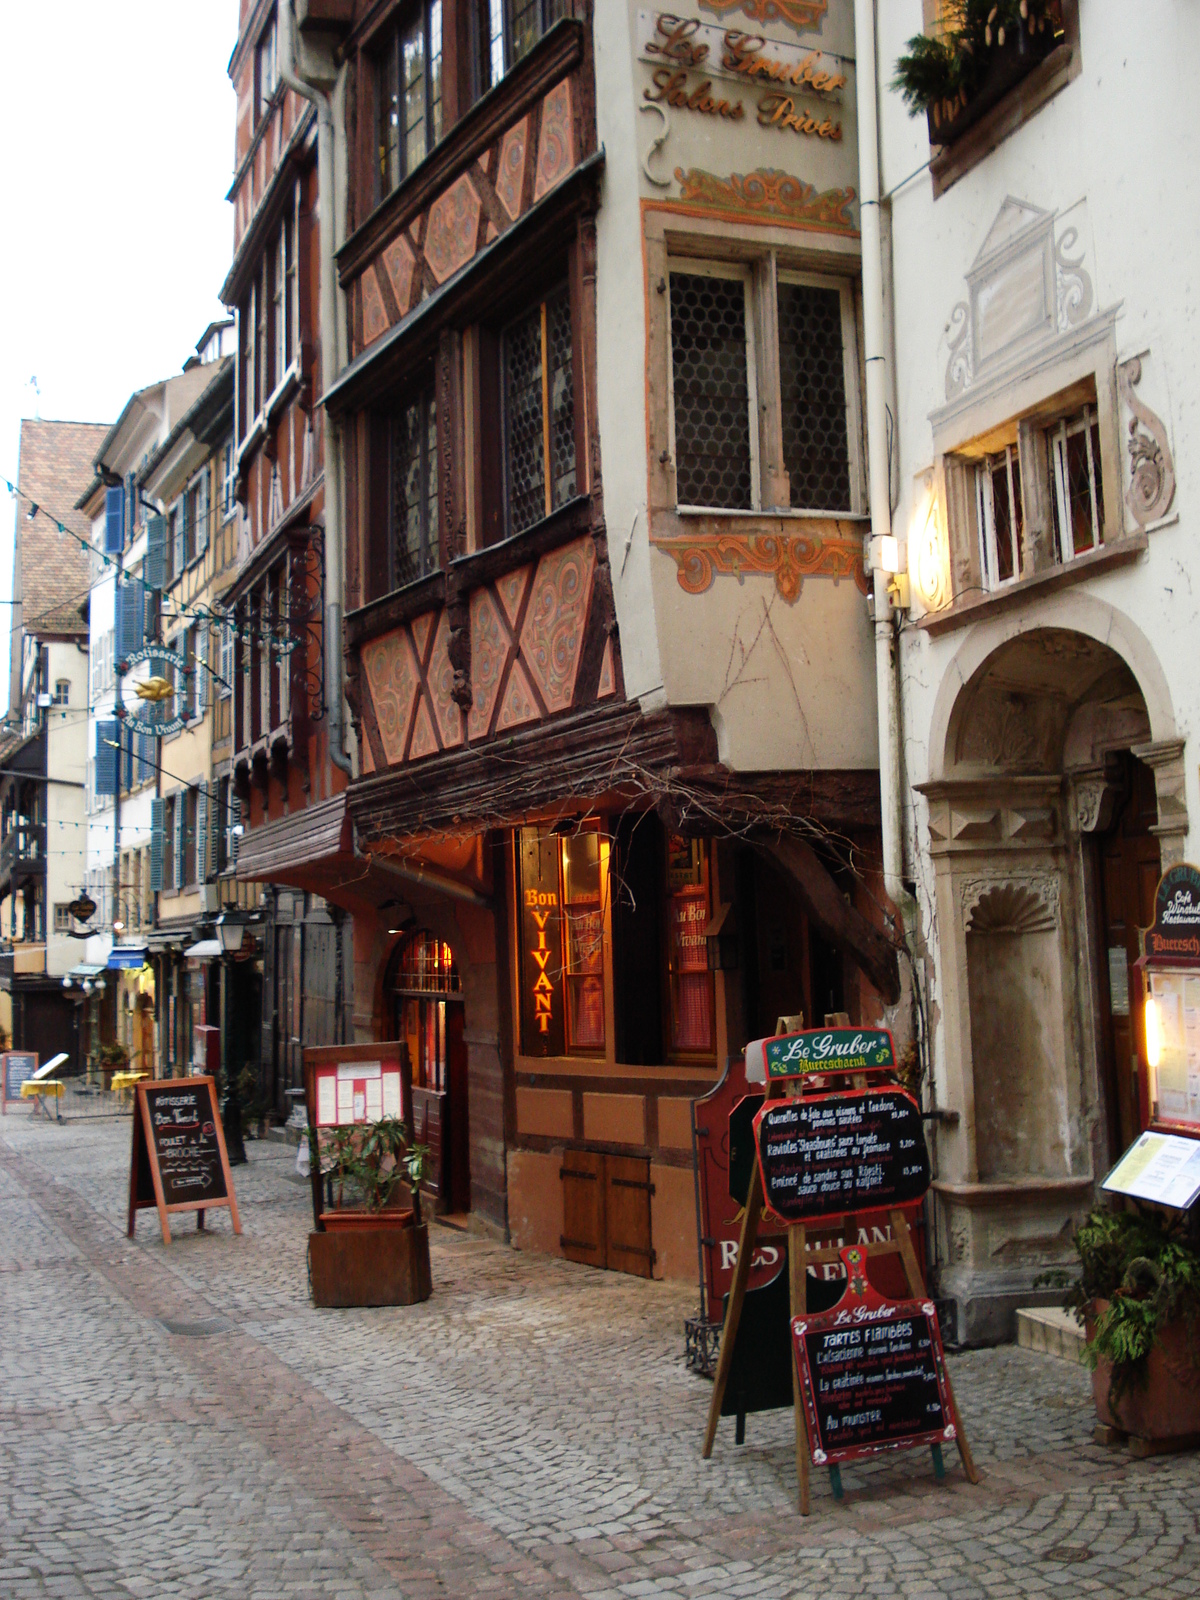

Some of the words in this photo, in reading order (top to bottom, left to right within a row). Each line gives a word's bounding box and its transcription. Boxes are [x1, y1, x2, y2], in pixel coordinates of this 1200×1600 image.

[645, 13, 710, 66] Le
[723, 29, 847, 92] Gruber
[643, 69, 744, 120] Salons
[757, 93, 843, 141] Privés
[122, 713, 135, 728] Au
[135, 721, 152, 734] Bon
[155, 718, 184, 735] Vivant
[525, 889, 557, 906] Bon
[531, 910, 554, 1033] VIVANT
[782, 1039, 810, 1062] Le
[812, 1034, 877, 1059] Gruber
[800, 1108, 808, 1120] de
[802, 1171, 812, 1184] de
[833, 1309, 852, 1326] Le
[852, 1303, 896, 1323] Gruber
[826, 1415, 839, 1430] Au
